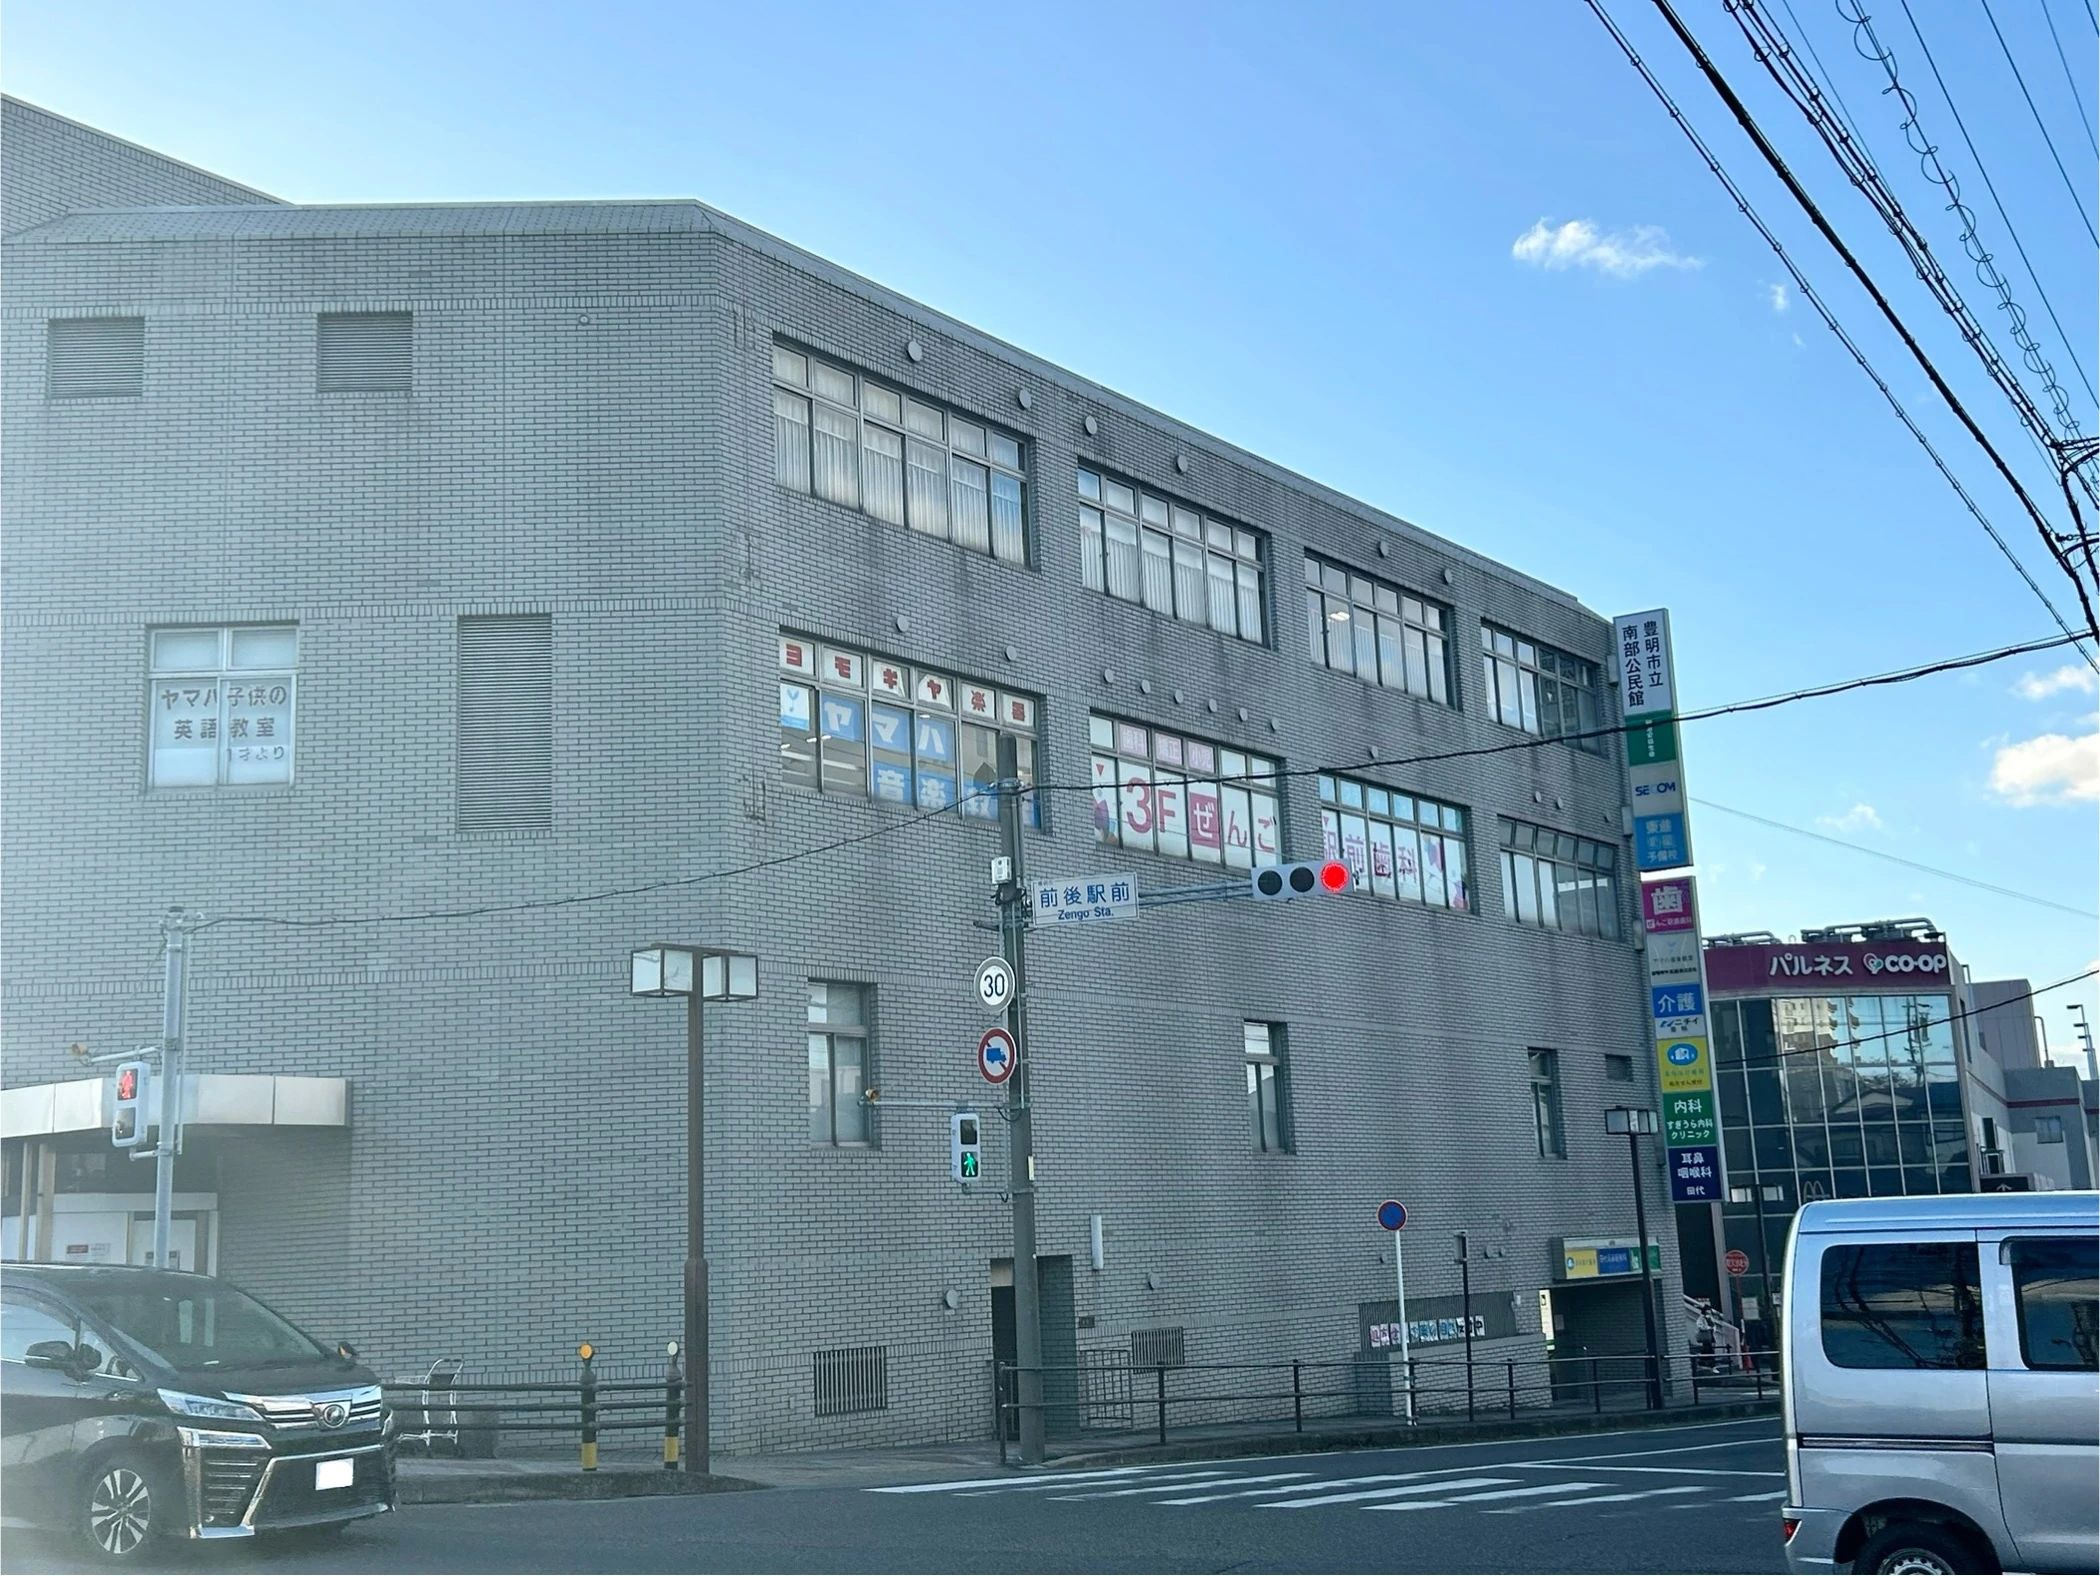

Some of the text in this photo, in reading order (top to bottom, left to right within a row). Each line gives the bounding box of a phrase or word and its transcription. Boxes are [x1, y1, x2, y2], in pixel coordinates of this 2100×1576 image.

[1622, 625, 1644, 707] 南部公民館
[174, 717, 275, 740] 英語教室
[823, 701, 945, 755] ヤマハ
[1039, 881, 1130, 909] 前後駅前
[1651, 885, 1683, 915] 歯
[1057, 906, 1115, 921] Zengo Sta.
[1769, 952, 1853, 976] パルネス
[983, 973, 1005, 998] 30
[1657, 991, 1696, 1013] 介護
[1674, 1098, 1703, 1115] 内科
[1666, 1118, 1713, 1131] すぎうら内科
[1670, 1129, 1711, 1140] クリニック
[1680, 1152, 1705, 1165] 耳鼻
